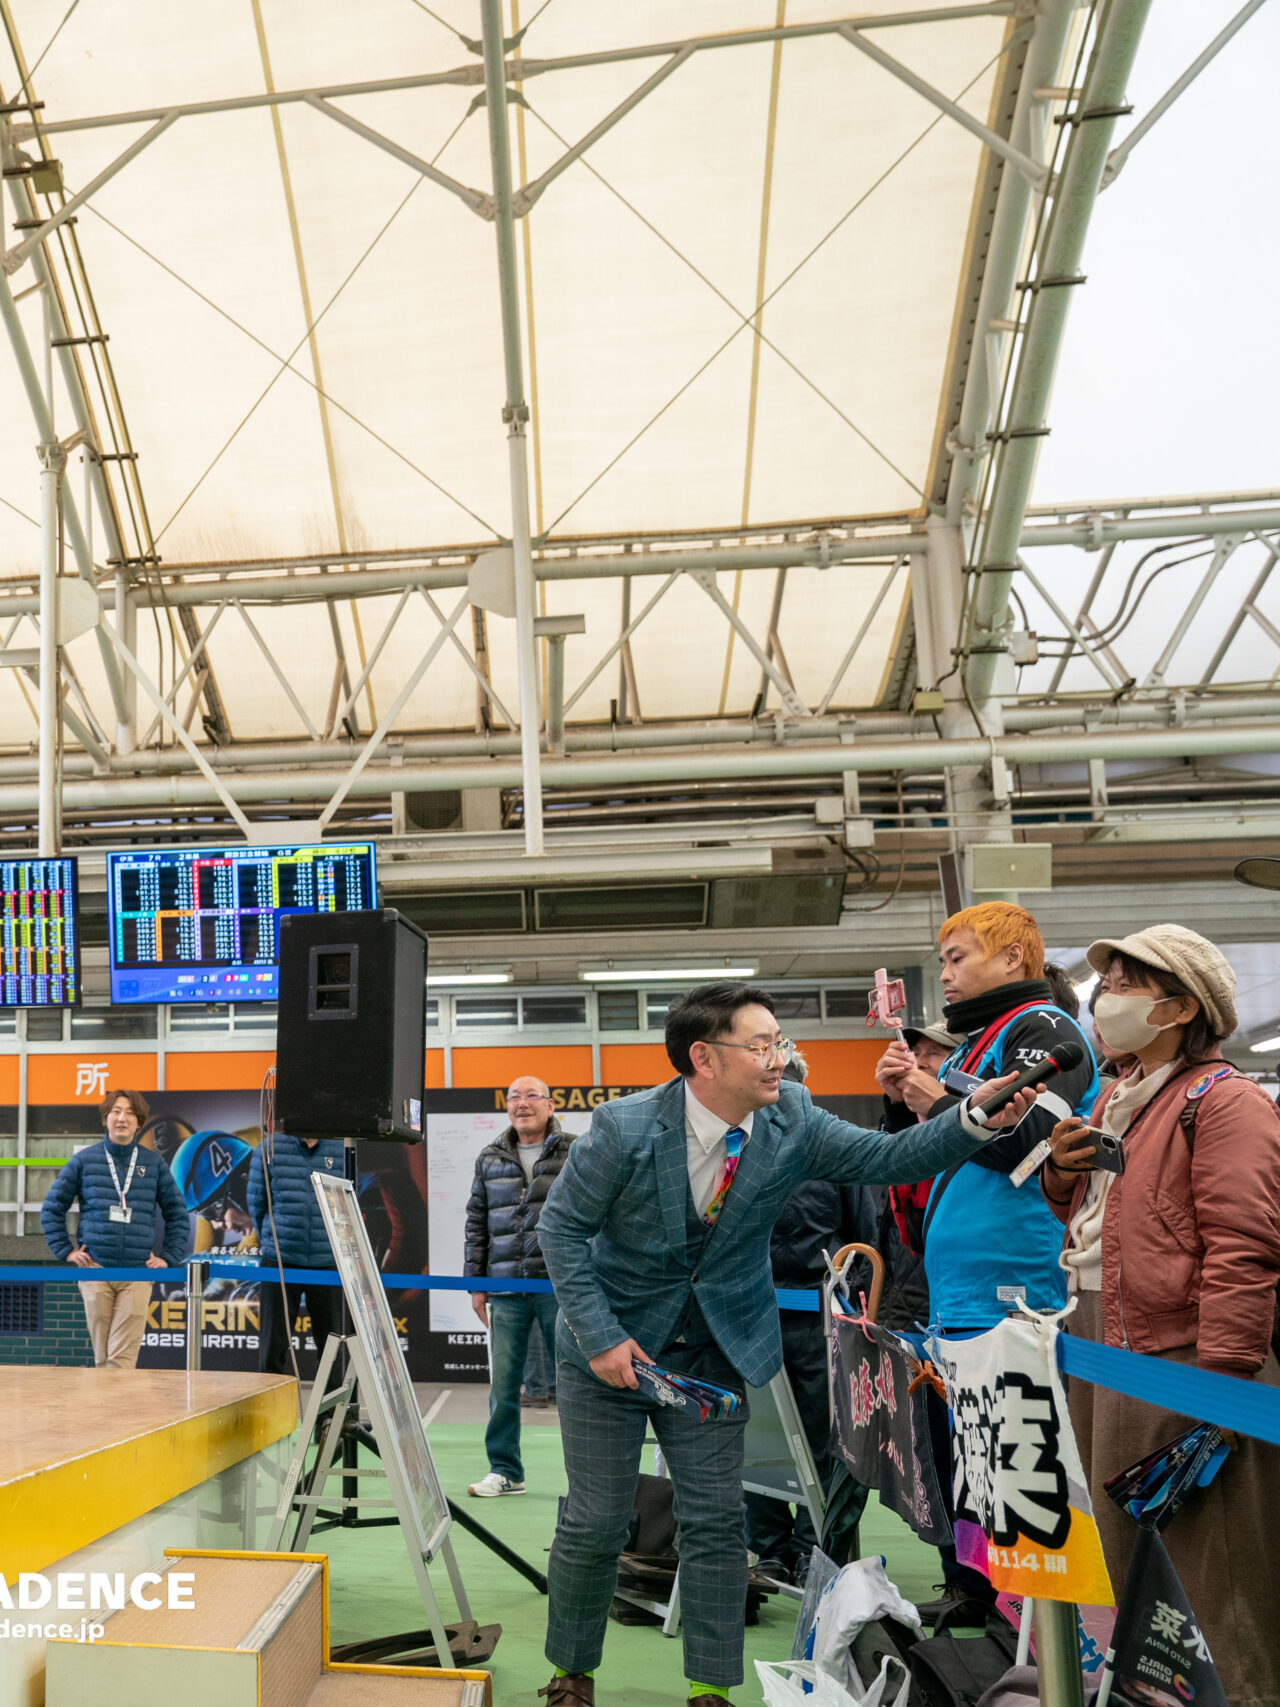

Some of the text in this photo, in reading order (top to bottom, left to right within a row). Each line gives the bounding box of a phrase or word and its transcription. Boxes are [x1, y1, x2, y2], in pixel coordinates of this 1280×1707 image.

[76, 1063, 109, 1095] 所
[494, 1088, 621, 1110] MSAGE
[209, 1141, 232, 1177] 4
[147, 1301, 261, 1331] KERIN
[448, 1334, 488, 1345] KEIRI
